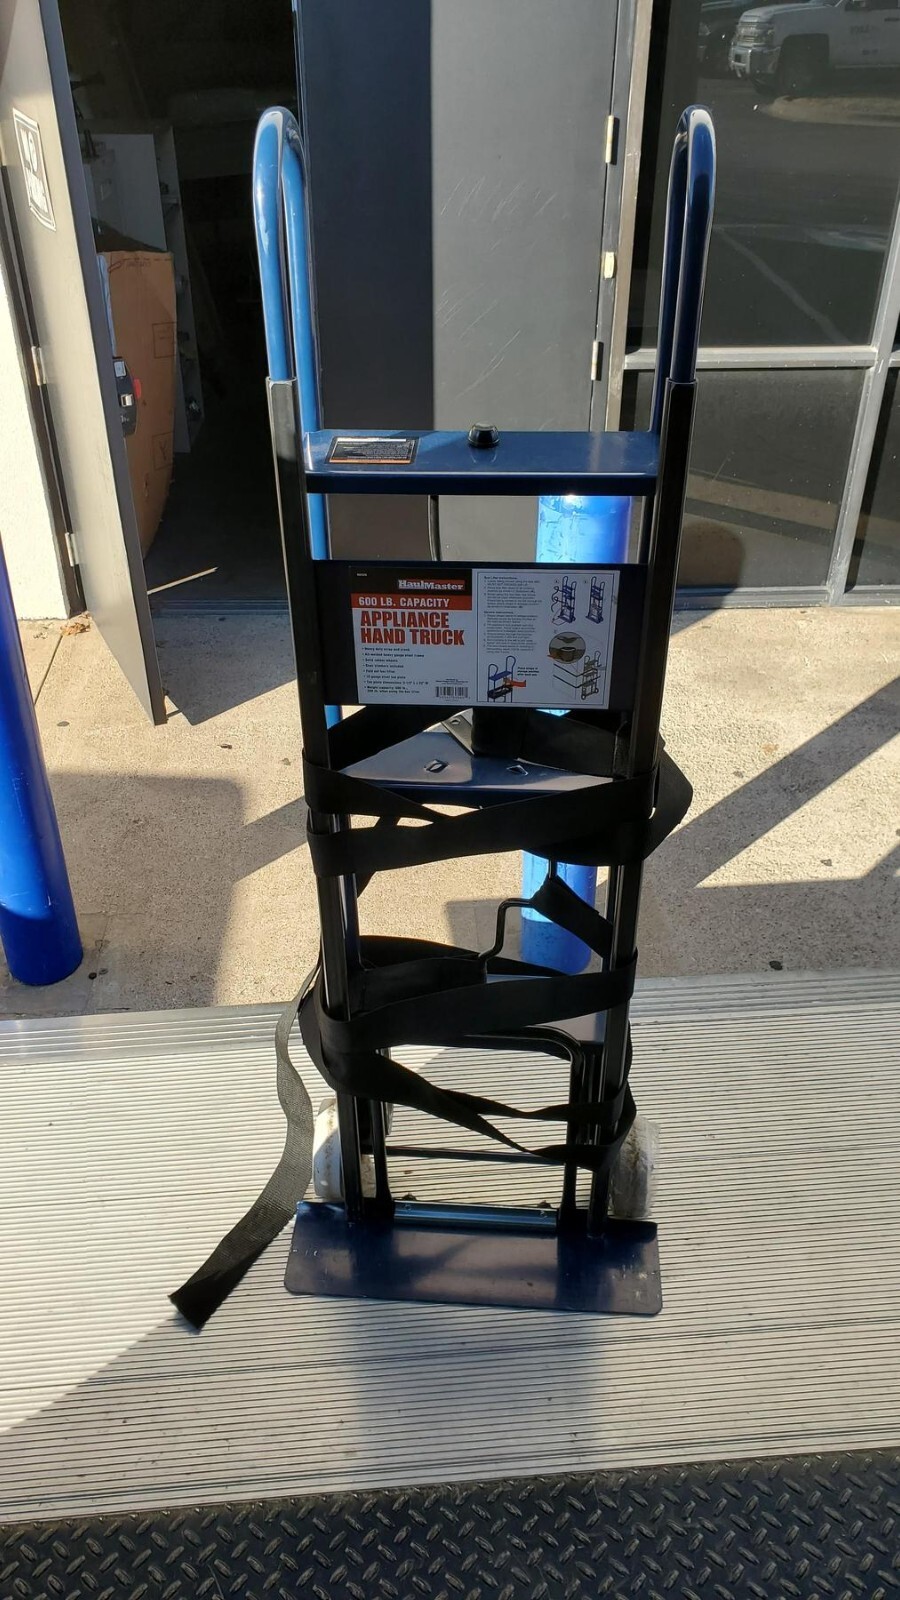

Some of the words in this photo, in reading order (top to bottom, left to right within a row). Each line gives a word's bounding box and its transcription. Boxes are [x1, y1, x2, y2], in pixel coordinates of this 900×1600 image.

[398, 579, 464, 590] HaulMaster
[358, 596, 377, 606] 600
[380, 598, 396, 606] LB.
[400, 598, 450, 608] CAPACITY
[360, 610, 450, 628] APPLIANCE
[360, 628, 406, 644] HAND
[409, 629, 464, 646] TRUCK
